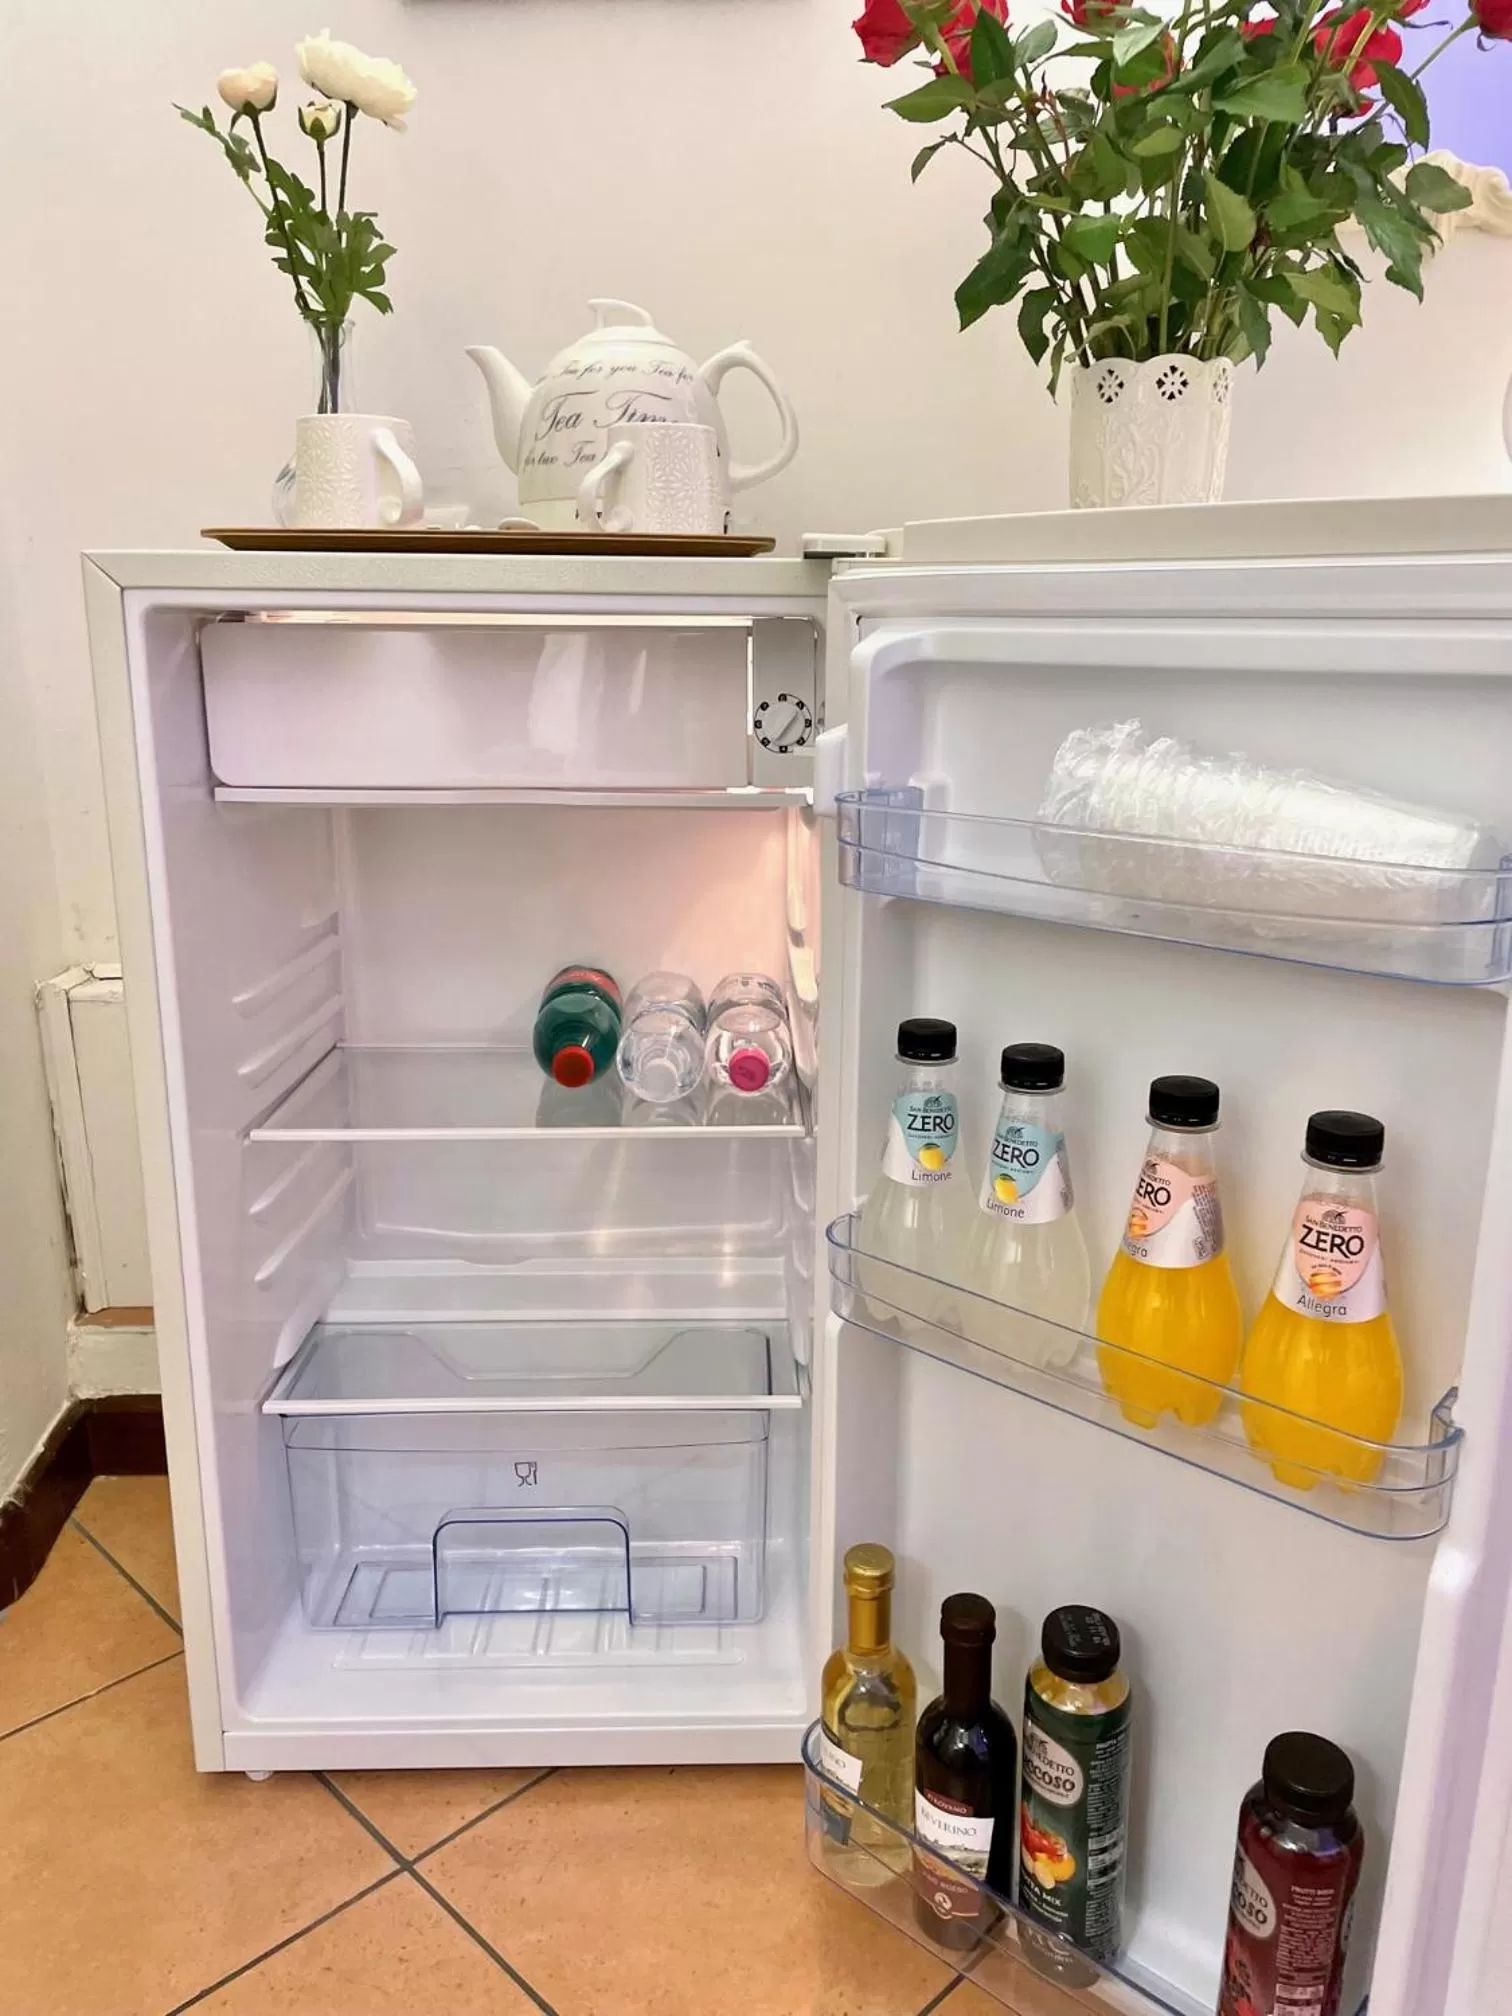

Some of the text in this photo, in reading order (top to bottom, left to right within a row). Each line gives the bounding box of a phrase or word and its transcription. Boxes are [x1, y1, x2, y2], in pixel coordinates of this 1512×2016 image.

[604, 365, 636, 379] you
[535, 389, 676, 441] Tea Tim
[563, 440, 597, 468] Tea
[907, 1113, 955, 1133] ZERO
[992, 1139, 1040, 1169] ZERO
[911, 1169, 952, 1183] Limone
[1135, 1176, 1171, 1208] ERO
[986, 1197, 1025, 1219] Limone
[1320, 1219, 1363, 1233] BENEDETTO
[1127, 1241, 1148, 1258] egra
[1299, 1223, 1365, 1259] ZERO
[1297, 1295, 1347, 1318] Allegra
